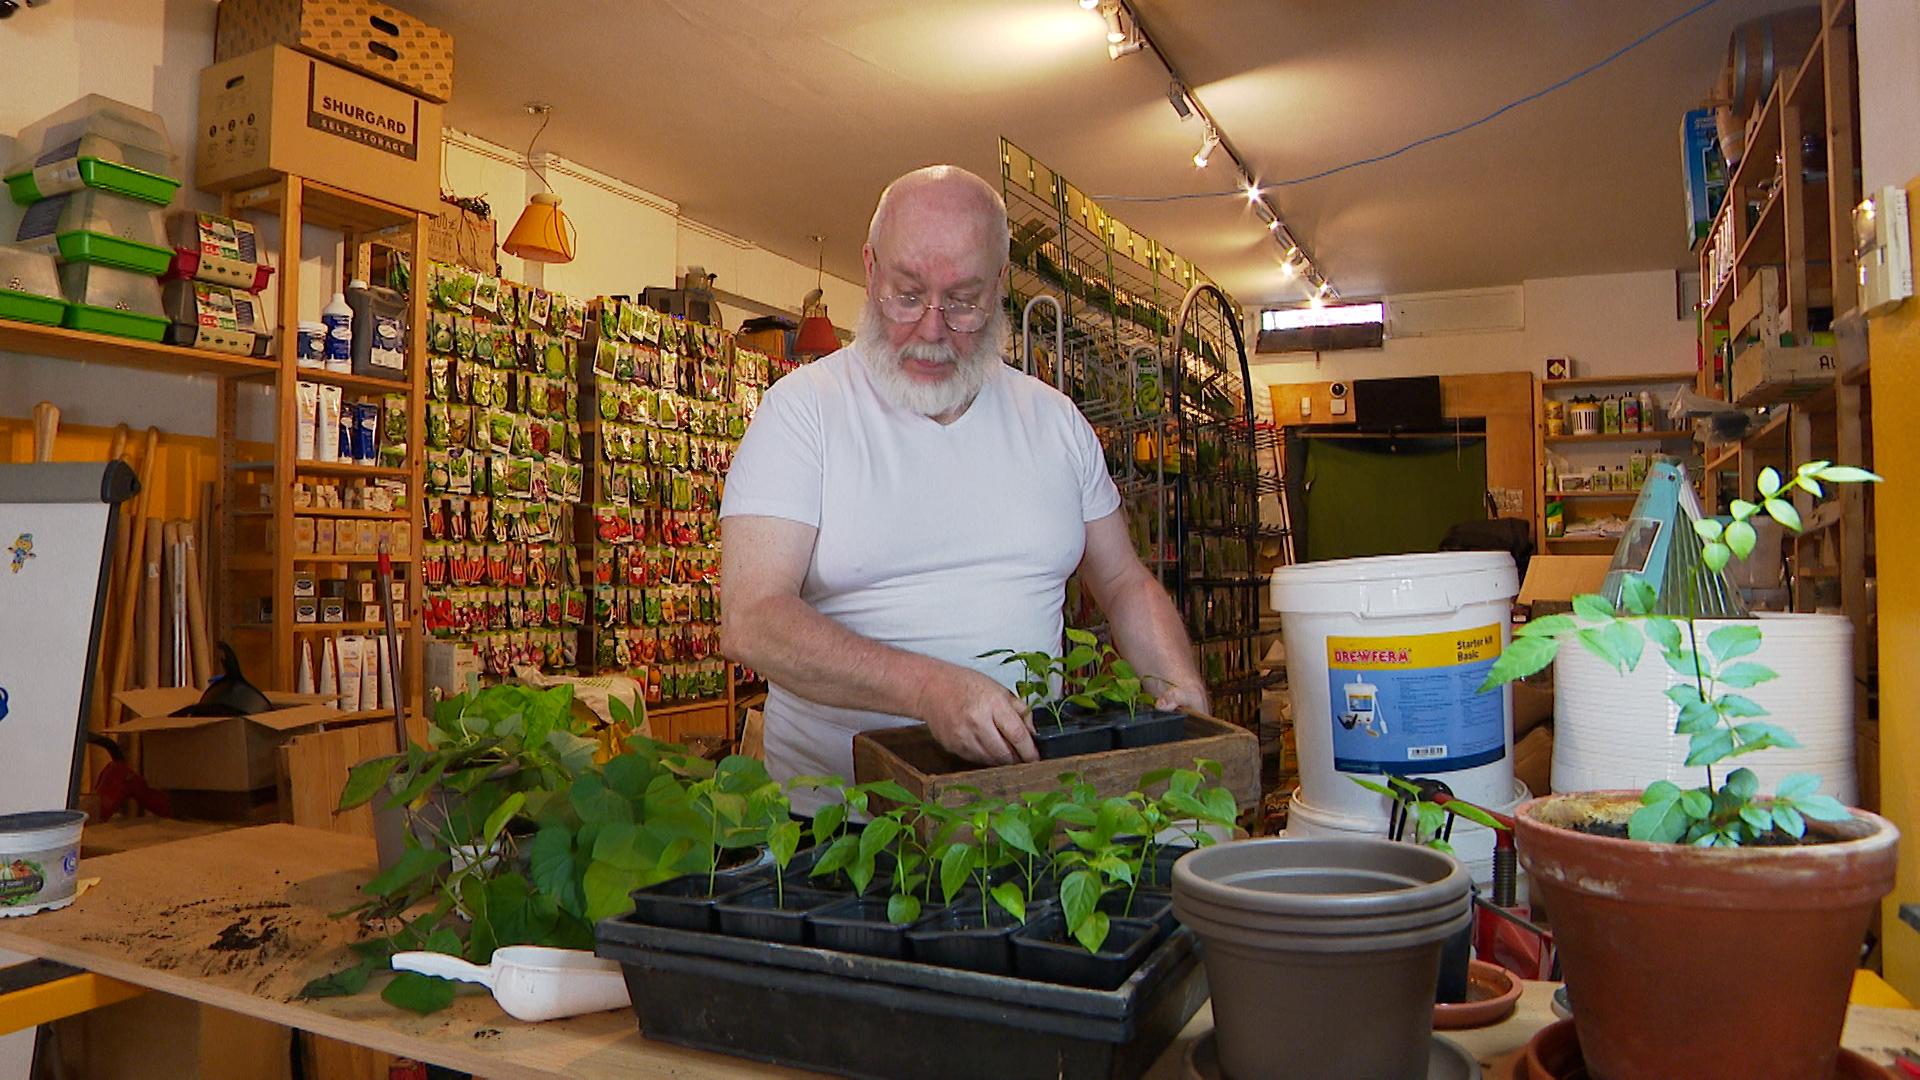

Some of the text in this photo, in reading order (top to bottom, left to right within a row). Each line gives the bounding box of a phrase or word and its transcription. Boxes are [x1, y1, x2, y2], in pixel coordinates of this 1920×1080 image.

[322, 95, 406, 134] SHURGARD
[320, 118, 406, 154] SELF-STORAGE
[1457, 638, 1483, 650] Starter
[1457, 649, 1479, 662] Basic
